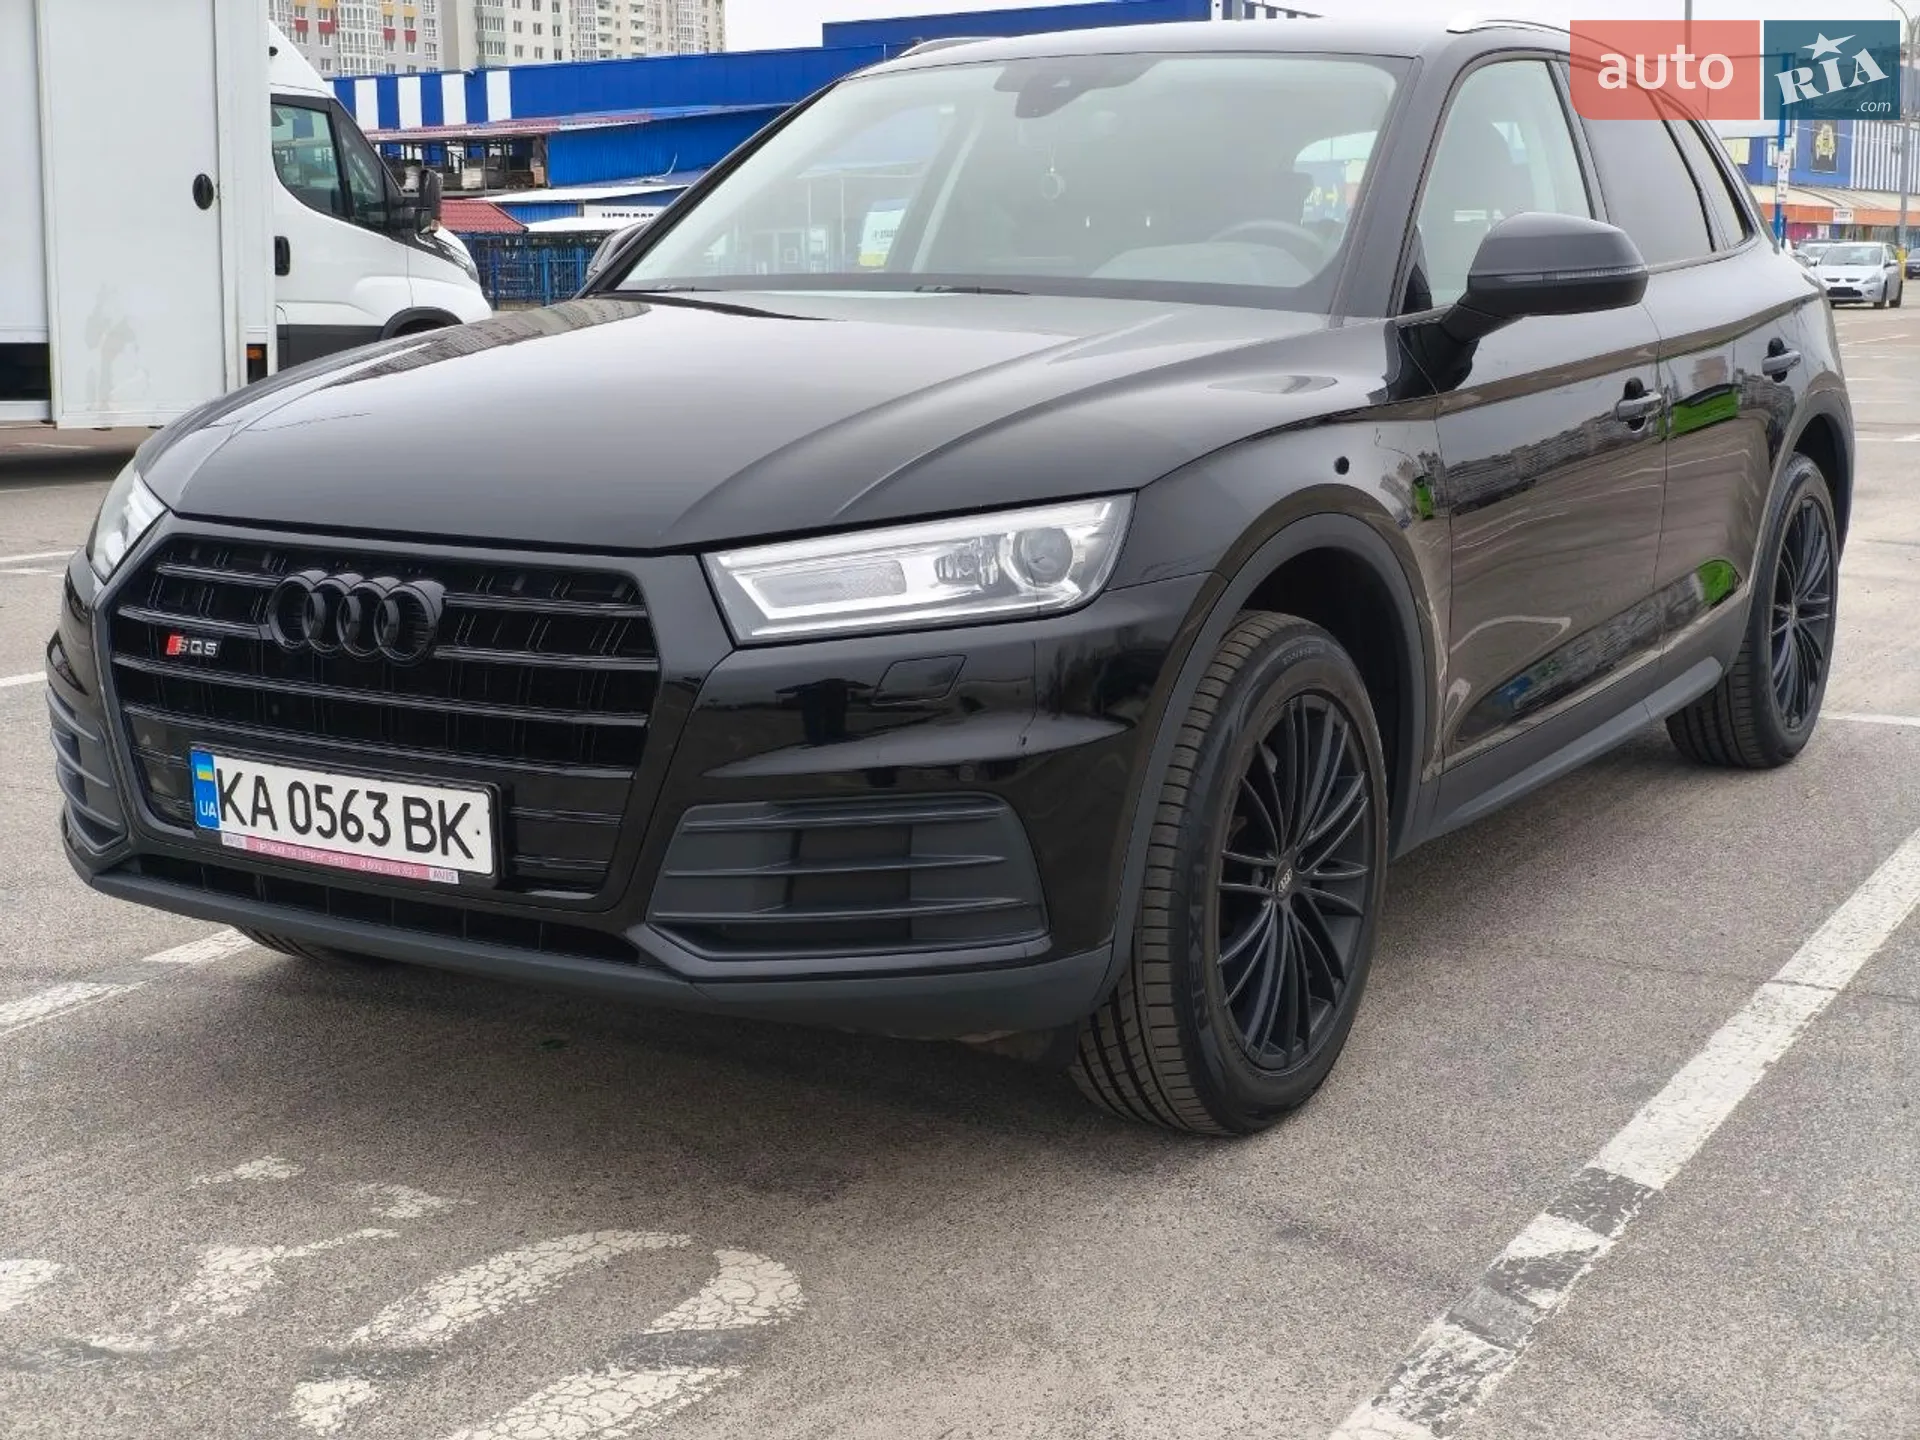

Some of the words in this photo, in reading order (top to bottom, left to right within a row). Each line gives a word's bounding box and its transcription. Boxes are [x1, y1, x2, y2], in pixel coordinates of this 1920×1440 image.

[175, 637, 217, 656] SQ5
[201, 800, 217, 818] UA
[217, 768, 278, 831] KA
[287, 780, 391, 846] 0563
[402, 796, 474, 859] BK
